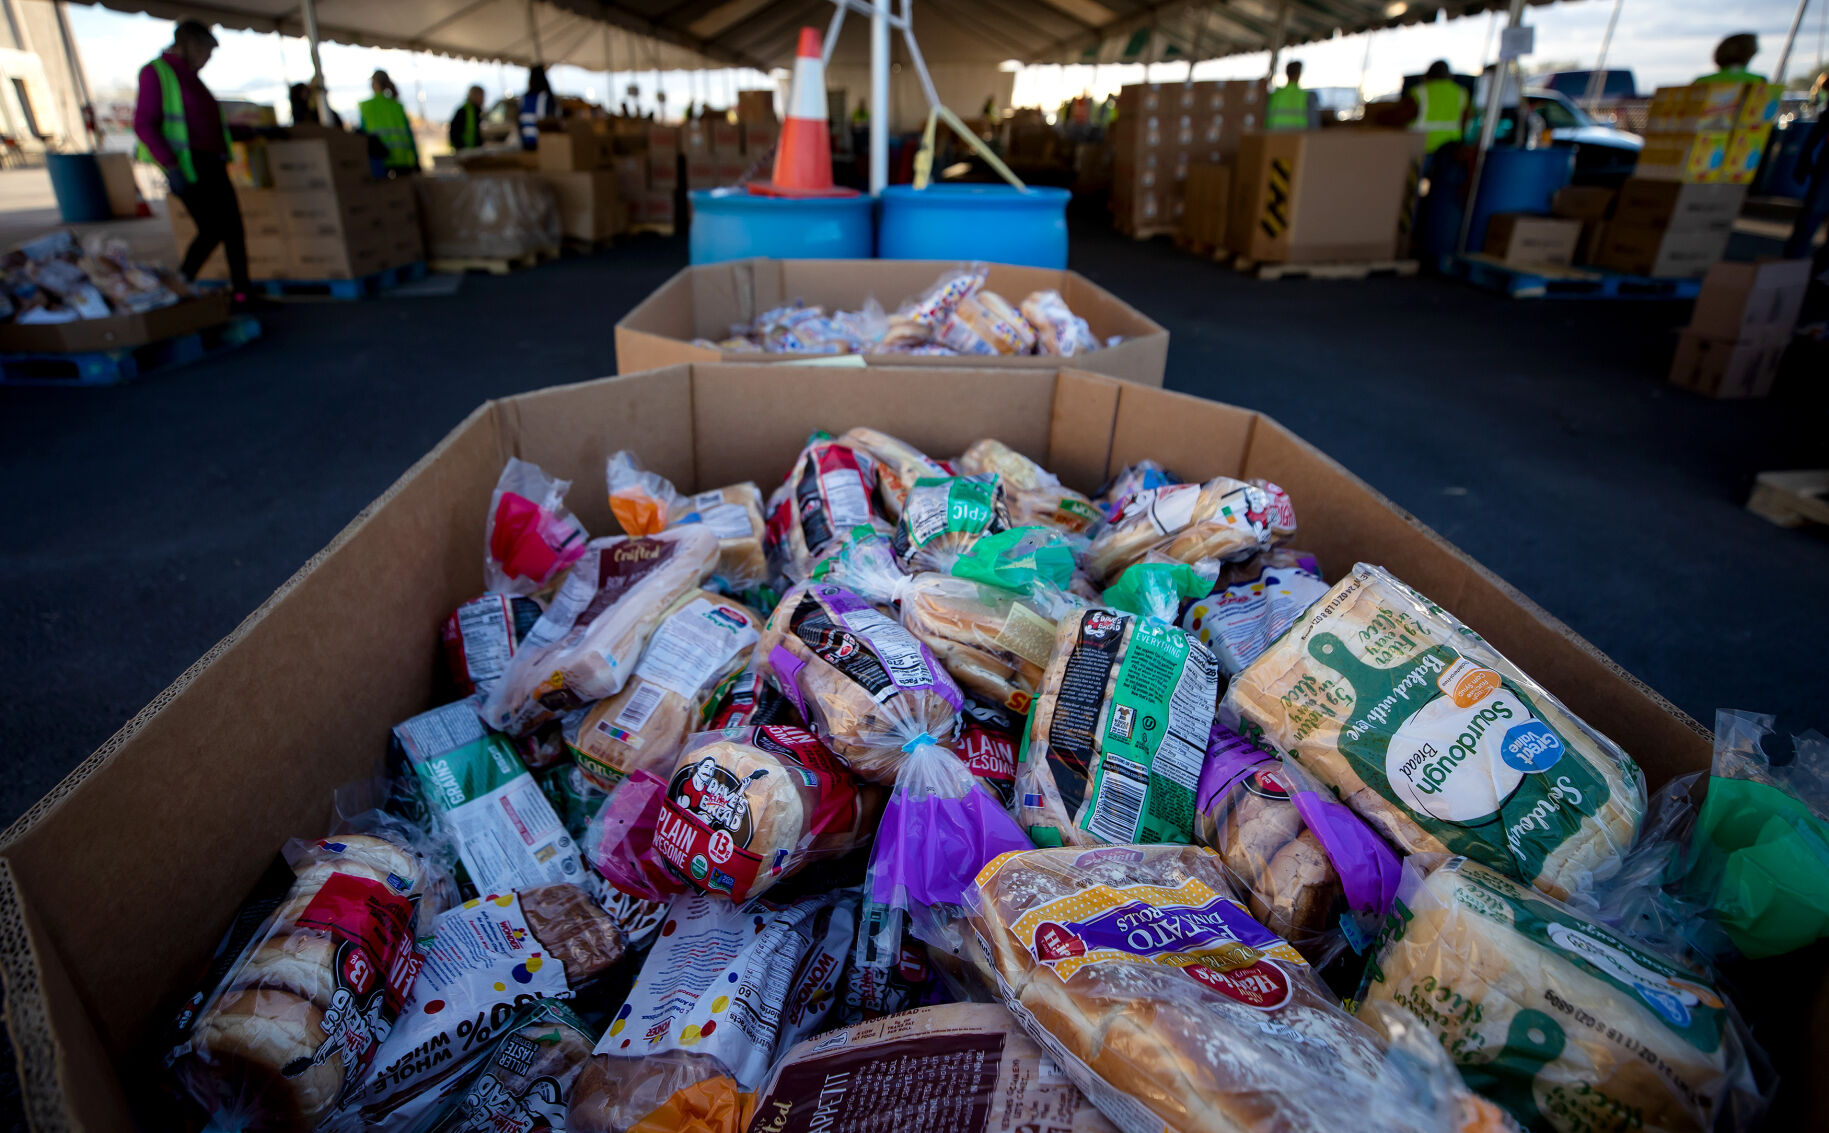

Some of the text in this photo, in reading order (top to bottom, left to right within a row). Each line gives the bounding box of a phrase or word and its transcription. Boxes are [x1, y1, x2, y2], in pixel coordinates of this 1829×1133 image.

[952, 503, 988, 522] EPIC
[1324, 604, 1335, 615] LB
[1337, 591, 1348, 602] OZ
[1356, 607, 1392, 646] slice
[1136, 632, 1182, 659] EVERYTHING
[1364, 628, 1398, 659] every
[1374, 633, 1416, 671] Fiber
[1280, 674, 1316, 712] slice
[1324, 683, 1354, 713] 5g
[1346, 653, 1446, 741] Baked with love
[1288, 695, 1319, 724] every
[1415, 700, 1513, 795] Sourdough
[1508, 731, 1541, 754] Value
[1517, 732, 1560, 766] Great
[1399, 742, 1438, 783] Bread
[432, 758, 465, 806] GRAINS
[705, 777, 749, 814] DAVE'S
[699, 794, 742, 832] BREAD
[659, 807, 698, 854] PLAIN
[1116, 906, 1167, 932] ROLLS
[1127, 914, 1244, 951] PTATO
[499, 920, 521, 950] WONDER
[737, 986, 751, 998] 60
[788, 952, 835, 1025] WONDER
[1420, 976, 1485, 1026] slice
[1544, 989, 1575, 1016] 680g
[729, 1013, 744, 1030] Facts
[759, 1004, 781, 1019] alories
[866, 1015, 887, 1025] YOUR
[890, 1008, 919, 1021] BREAD
[646, 1020, 671, 1038] WONDER
[861, 1028, 874, 1036] LOW
[861, 1033, 876, 1041] FOOD
[887, 1023, 904, 1031] TRANS
[378, 1032, 451, 1079] WHEAT
[497, 1053, 532, 1077] KILLER
[502, 1040, 537, 1062] TASTE
[374, 1047, 453, 1094] WHOLE
